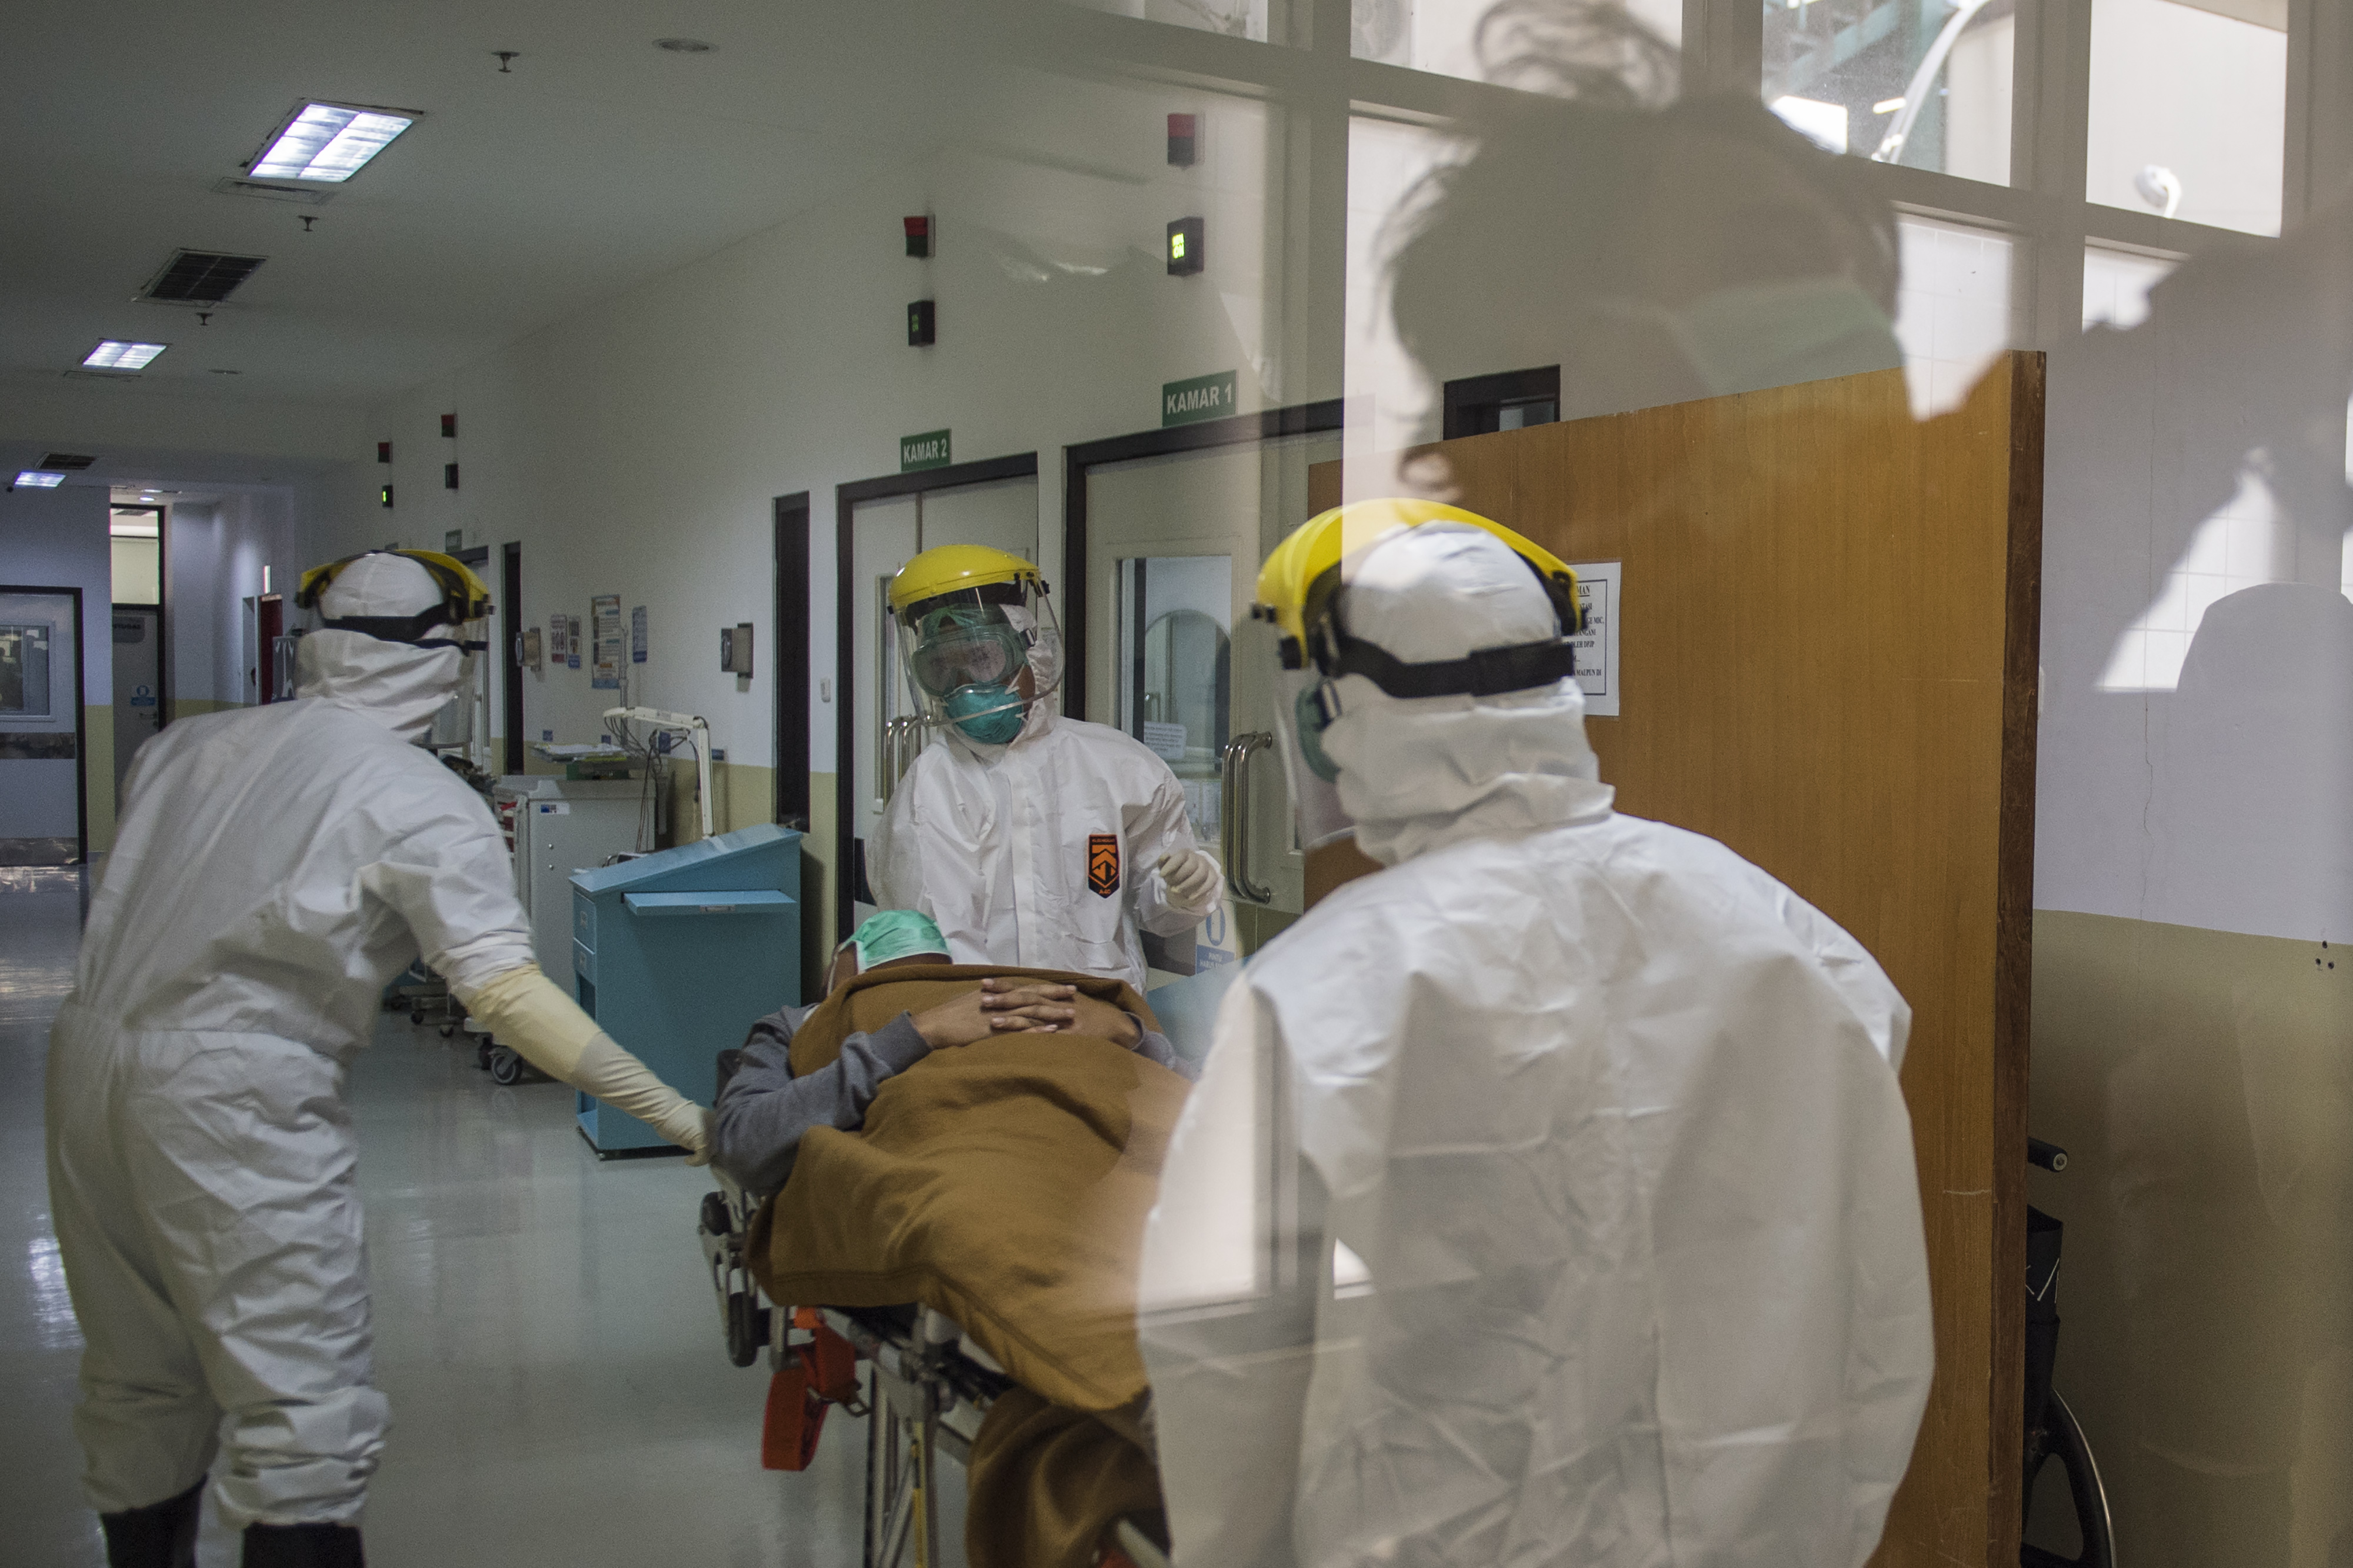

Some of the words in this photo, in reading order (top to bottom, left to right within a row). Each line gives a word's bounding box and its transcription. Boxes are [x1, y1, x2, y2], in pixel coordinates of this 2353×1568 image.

[1167, 385, 1219, 415] KAMAR
[1225, 382, 1232, 403] 1
[904, 440, 939, 464] KAMAR
[941, 438, 947, 458] 2
